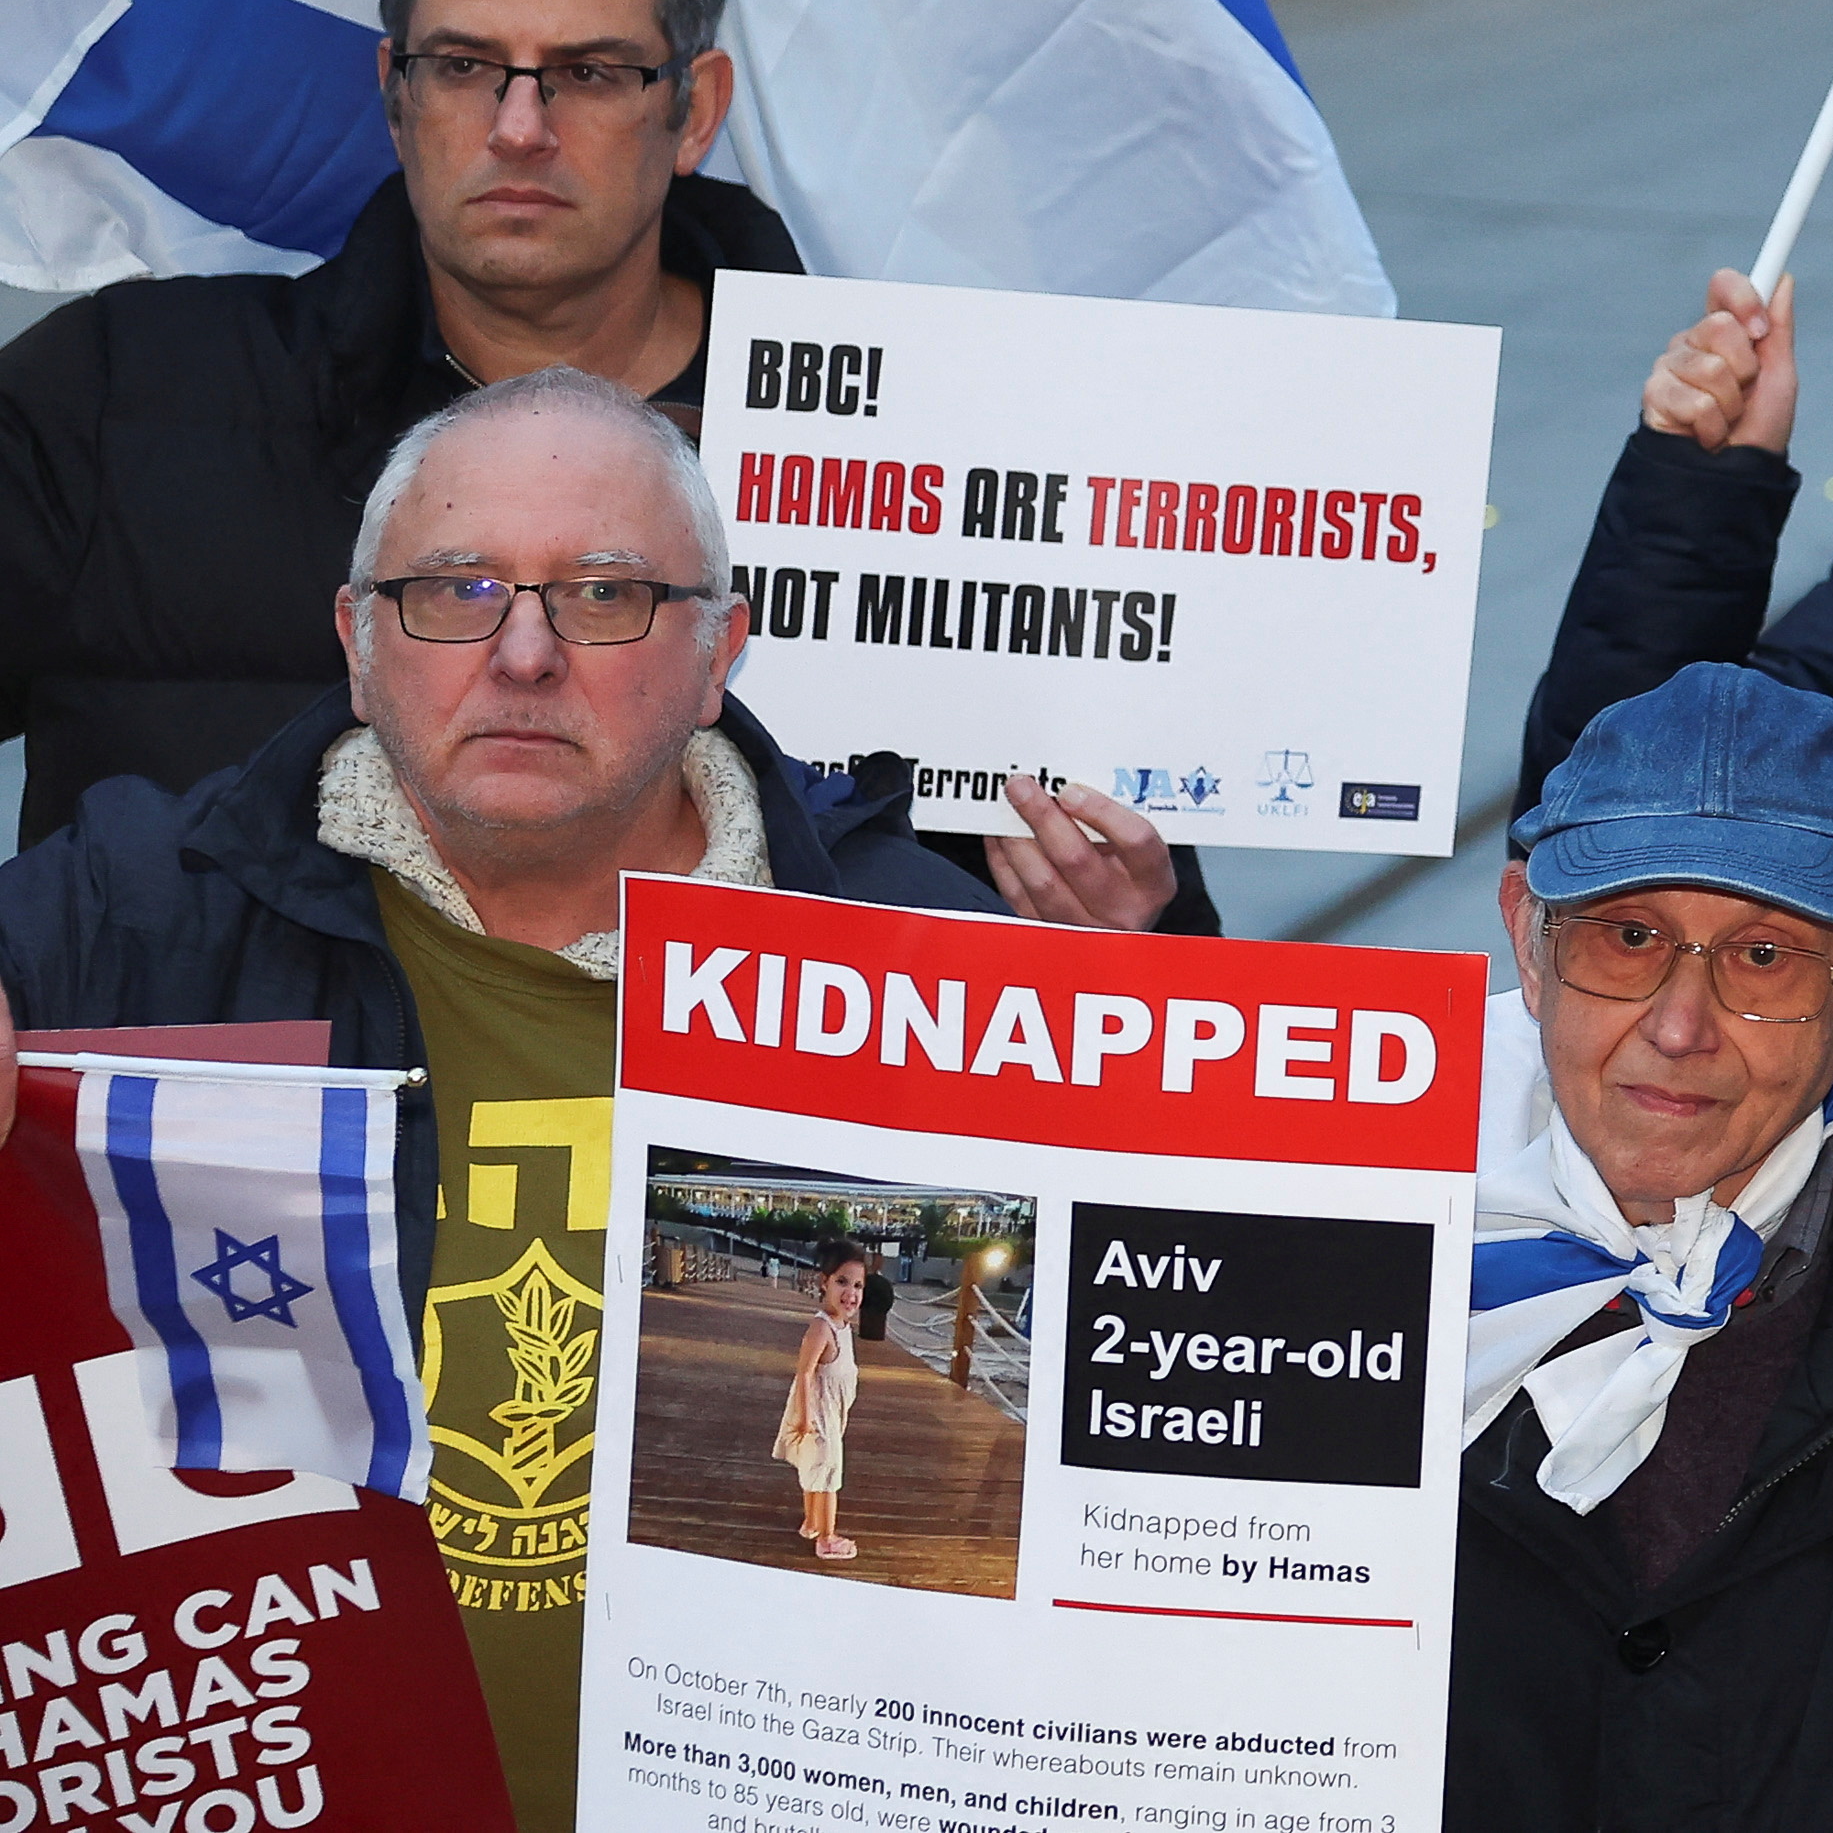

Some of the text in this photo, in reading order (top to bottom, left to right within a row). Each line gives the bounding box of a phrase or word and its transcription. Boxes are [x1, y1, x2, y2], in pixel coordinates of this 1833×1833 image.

[745, 339, 884, 417] BBC!
[735, 452, 1438, 574] HAMAS ARE TERRORISTS,
[731, 565, 1178, 663] NOT MILITANTS!
[660, 940, 1438, 1105] KIDNAPPED
[1092, 1239, 1223, 1295] Aviv
[1089, 1315, 1404, 1383] 2-year-old
[1088, 1389, 1263, 1448] Israeli
[1083, 1503, 1311, 1542] Kidnapped from
[1080, 1543, 1371, 1584] her home by Hamas
[173, 1557, 382, 1650] CAN
[628, 1656, 1398, 1759] On October 7th, nearly 200 innocent civilians were abducted from
[656, 1692, 1358, 1789] Israel into the Gaza Strip. Their whereabouts remain unknown.
[624, 1730, 1396, 1833] More than 3,000 women, men, and children, ranging in age from 3
[628, 1766, 701, 1796] months
[708, 1779, 727, 1800] to
[733, 1783, 759, 1806] 85
[765, 1791, 823, 1816] years
[831, 1799, 869, 1827] old,
[877, 1809, 931, 1833] were
[708, 1813, 747, 1833] and
